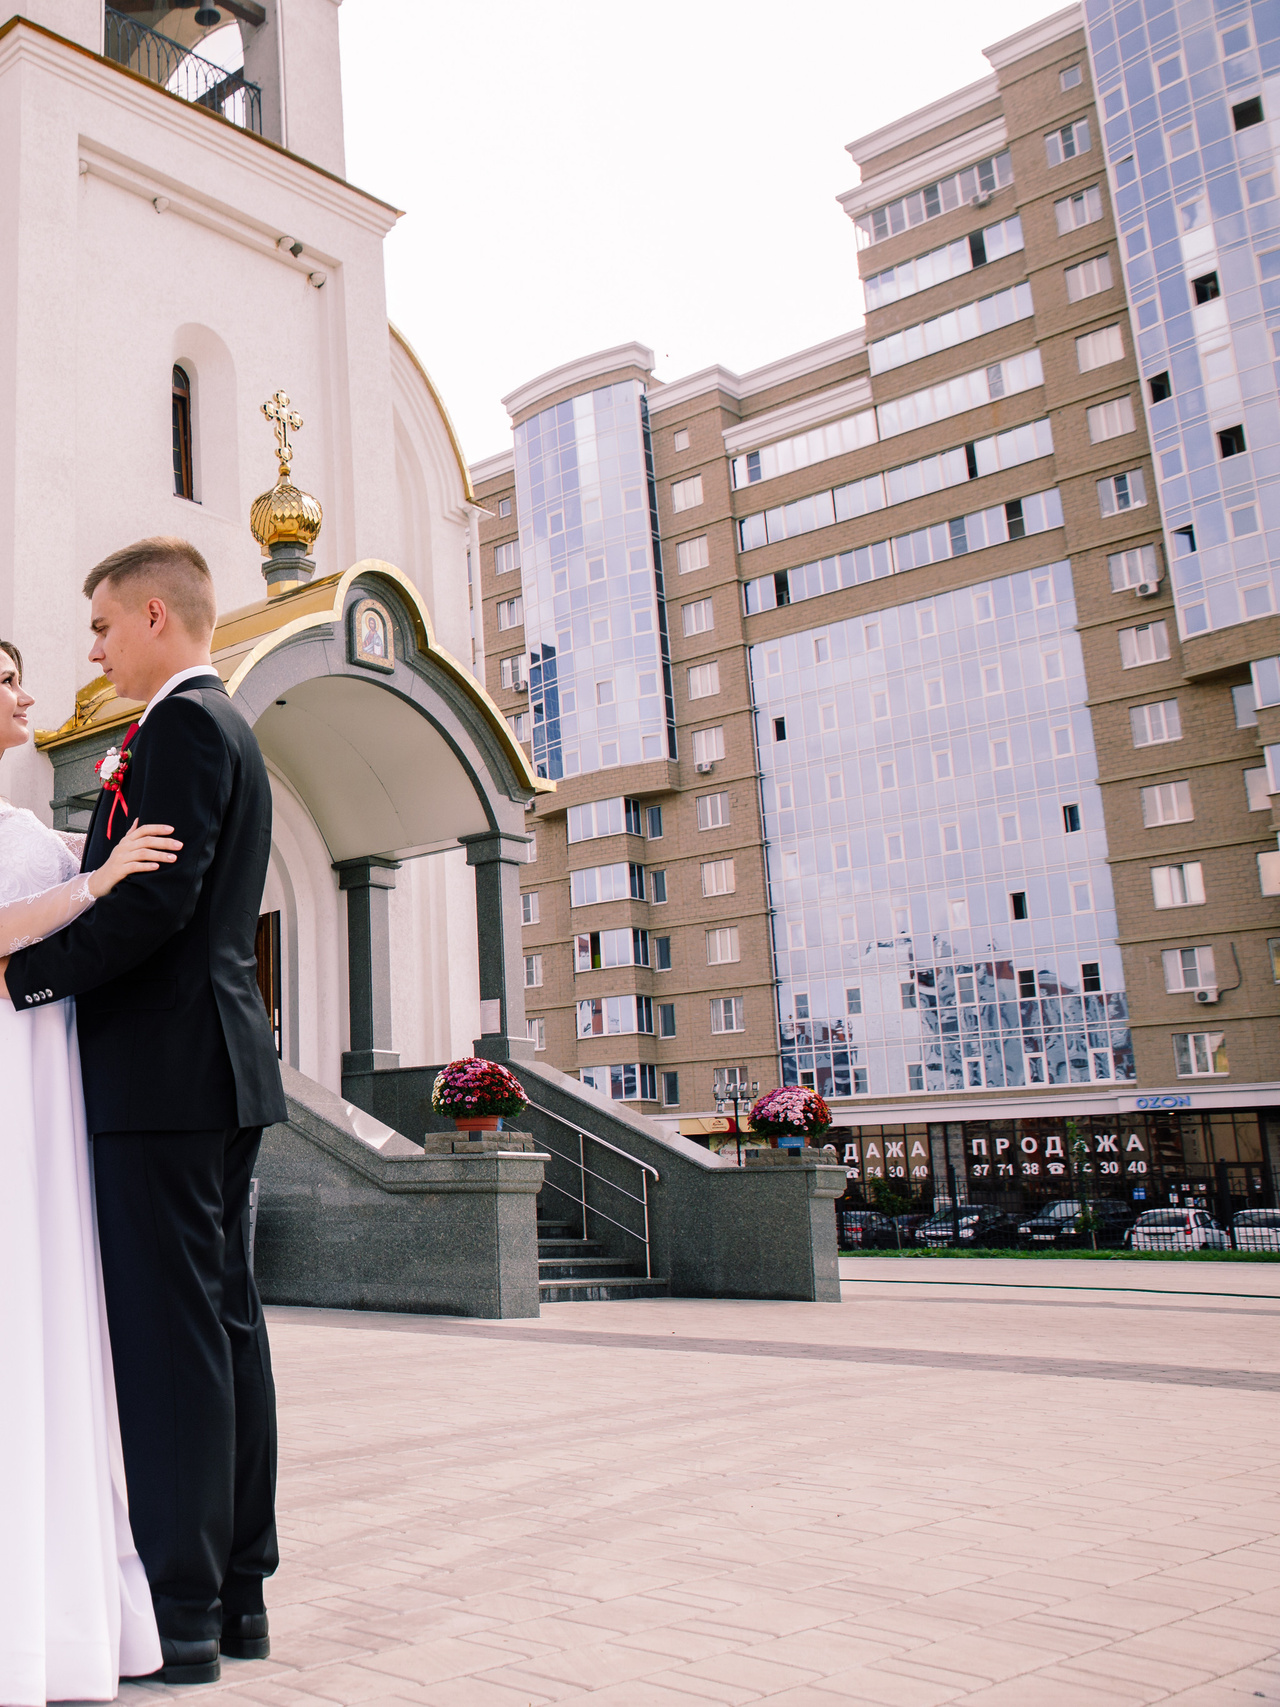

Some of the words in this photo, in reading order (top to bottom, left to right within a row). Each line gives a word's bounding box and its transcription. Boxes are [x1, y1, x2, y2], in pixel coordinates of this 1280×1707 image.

[1136, 1096, 1191, 1109] OZON
[888, 1166, 904, 1178] 30
[912, 1165, 928, 1177] 40
[973, 1164, 990, 1176] 37
[997, 1164, 1014, 1176] 71
[1022, 1163, 1039, 1175] 38
[1100, 1162, 1119, 1174] 30
[1127, 1161, 1147, 1174] 40
